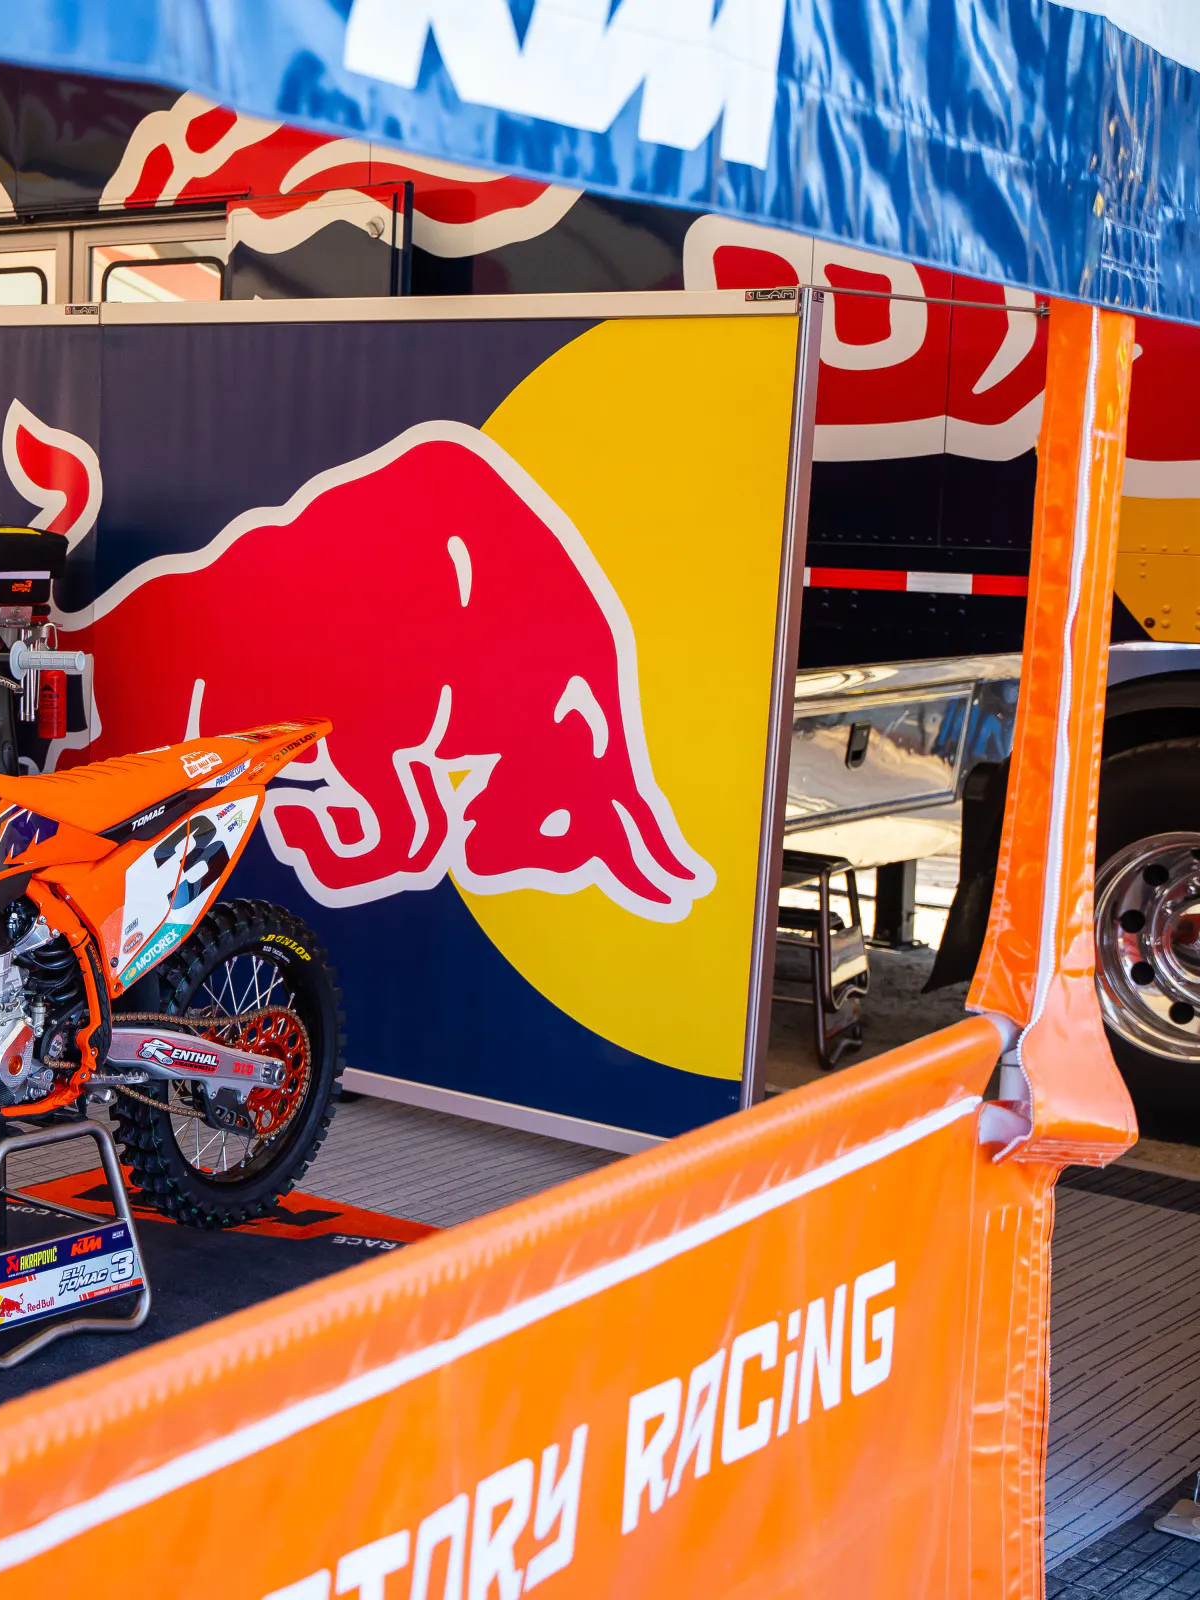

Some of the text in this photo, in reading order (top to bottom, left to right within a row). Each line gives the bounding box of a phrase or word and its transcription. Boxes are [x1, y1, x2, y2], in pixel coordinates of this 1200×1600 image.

[280, 732, 317, 755] DUNLOP
[215, 763, 246, 787] PROGRESSIVE
[131, 805, 166, 832] TOMAC
[154, 815, 231, 910] 3
[135, 928, 180, 971] MOTOREX
[264, 934, 312, 961] DUNLOP
[139, 1038, 218, 1066] RENTHAL
[70, 1234, 102, 1257] KTM
[332, 1235, 398, 1250] RACE
[63, 1265, 85, 1280] ELI
[110, 1249, 135, 1283] 3
[58, 1268, 109, 1296] TOMAC
[27, 1296, 55, 1313] Red Bull
